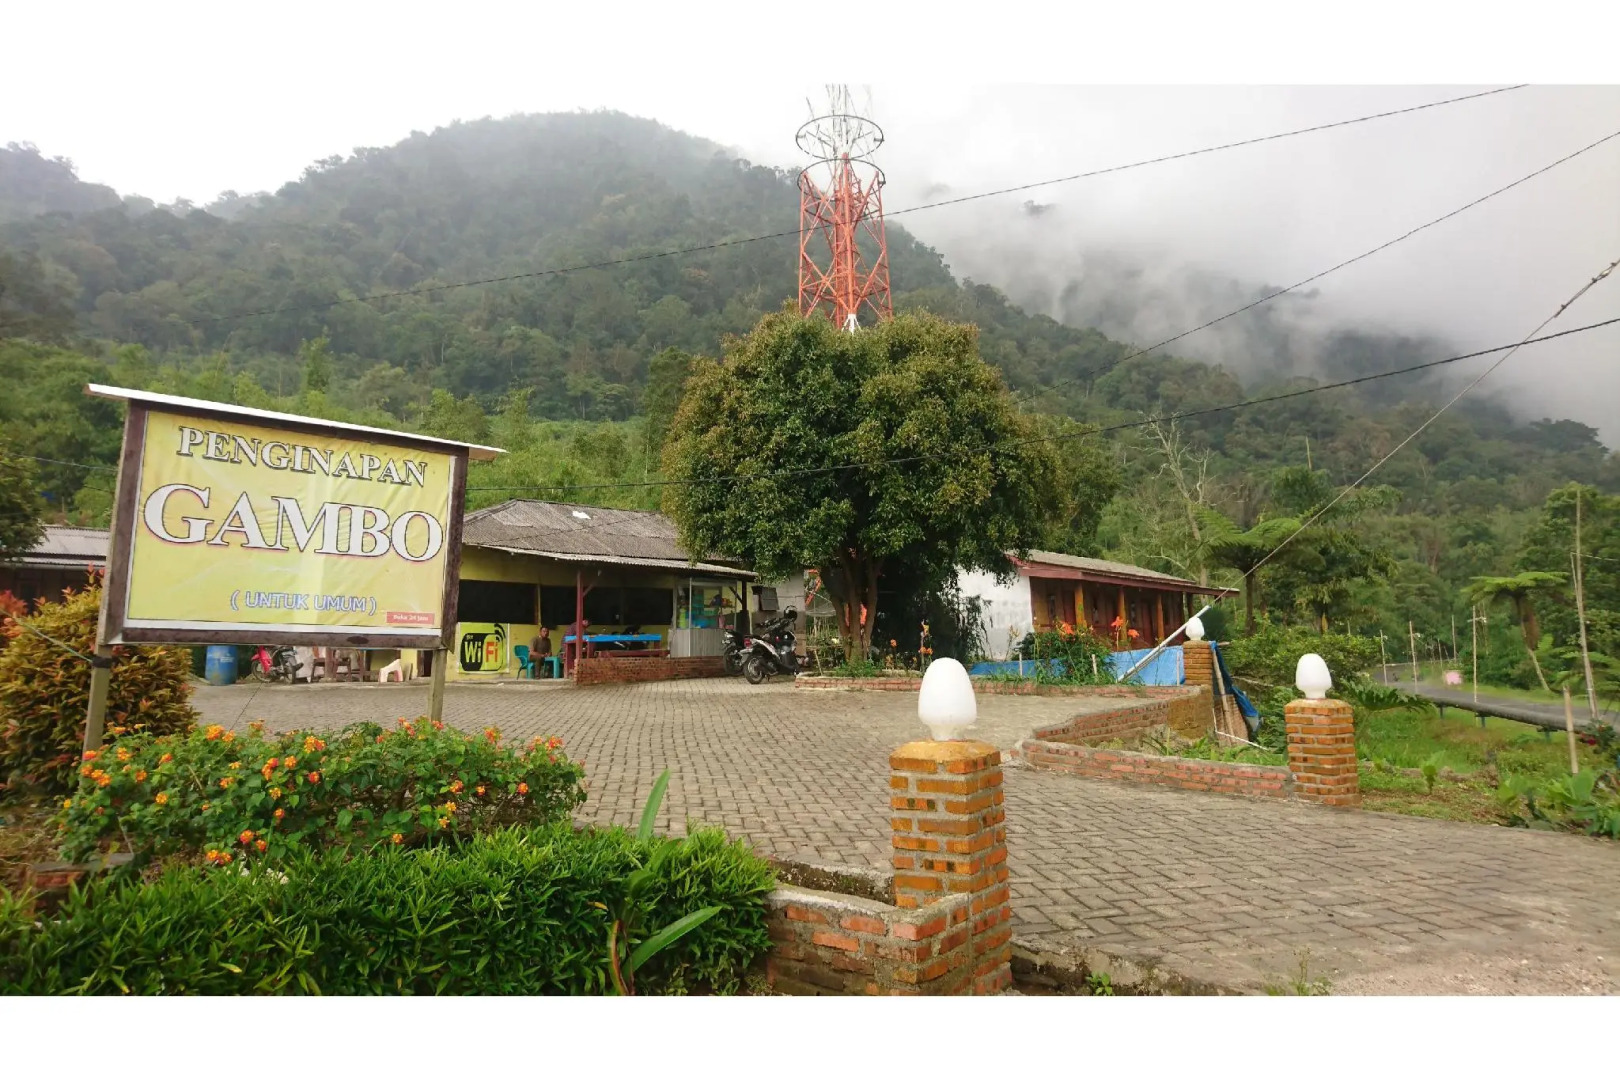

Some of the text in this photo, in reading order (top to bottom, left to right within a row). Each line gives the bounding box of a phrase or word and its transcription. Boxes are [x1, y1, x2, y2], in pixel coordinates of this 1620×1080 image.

[177, 426, 426, 487] PENGINAPAN
[143, 483, 444, 562] GAMBO
[464, 641, 498, 663] WiFi
